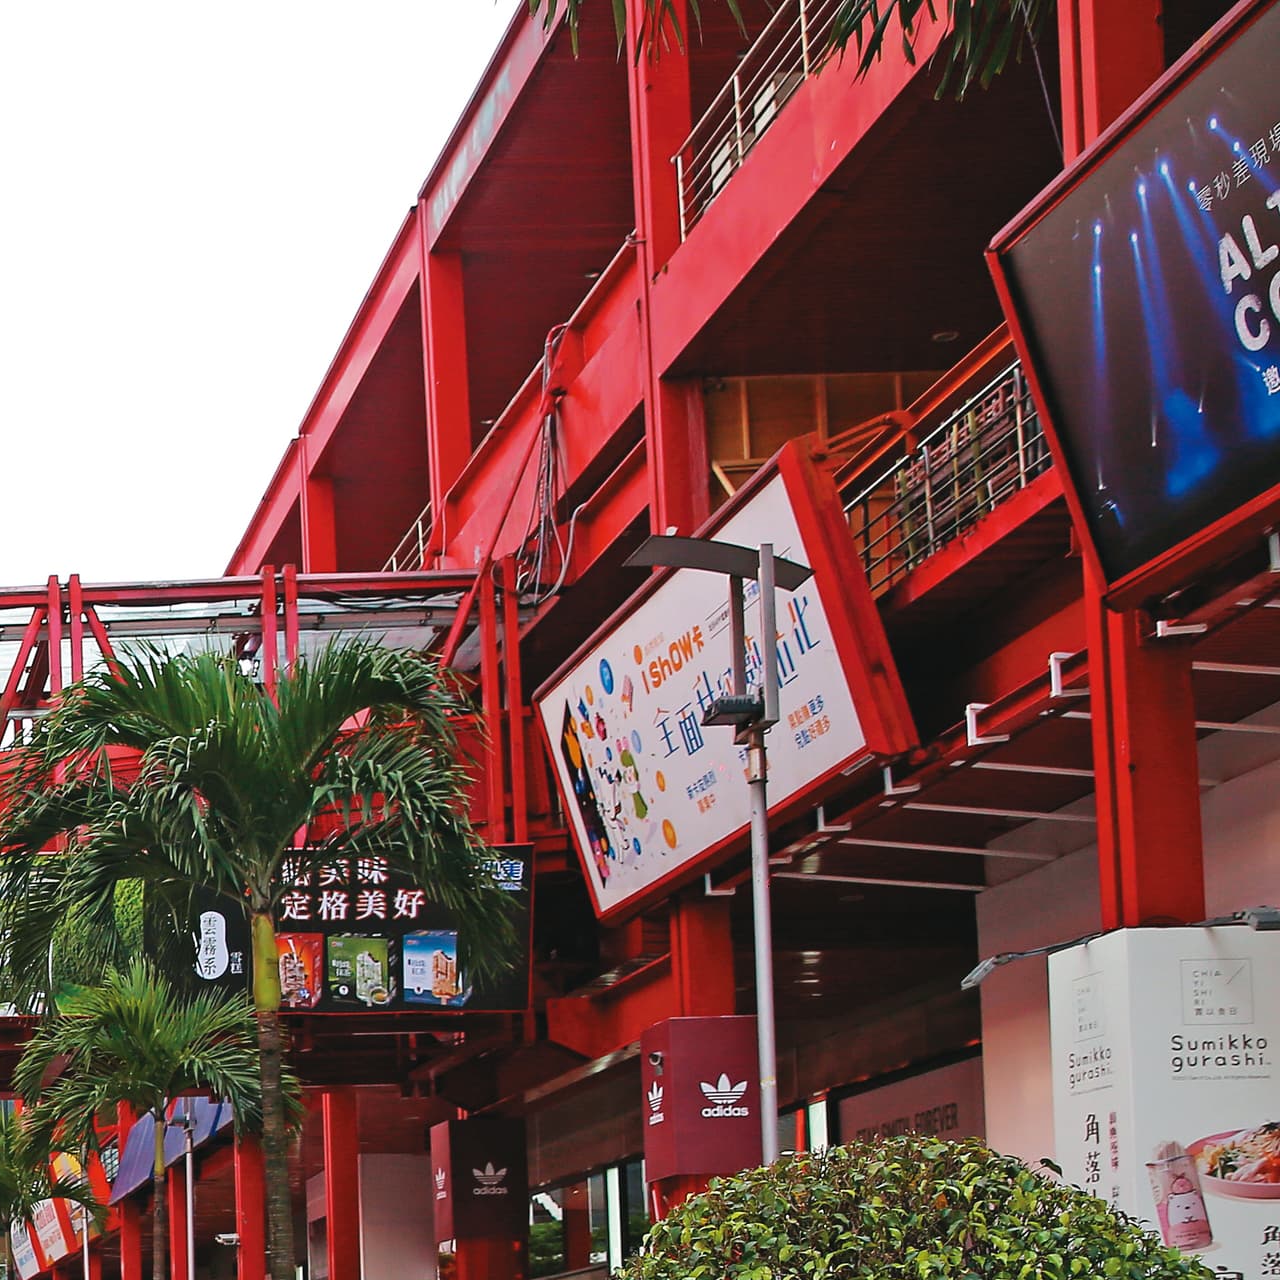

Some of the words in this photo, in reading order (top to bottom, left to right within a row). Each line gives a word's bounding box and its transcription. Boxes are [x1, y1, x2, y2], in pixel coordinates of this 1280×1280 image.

[1234, 271, 1280, 351] C
[281, 888, 426, 921] 定格美好
[1171, 1033, 1268, 1051] Sumikko
[1068, 1046, 1112, 1068] Sumikko
[1171, 1053, 1265, 1072] gurashi
[1069, 1063, 1113, 1089] gurashi
[701, 1105, 749, 1118] adidas
[473, 1186, 508, 1195] adidas
